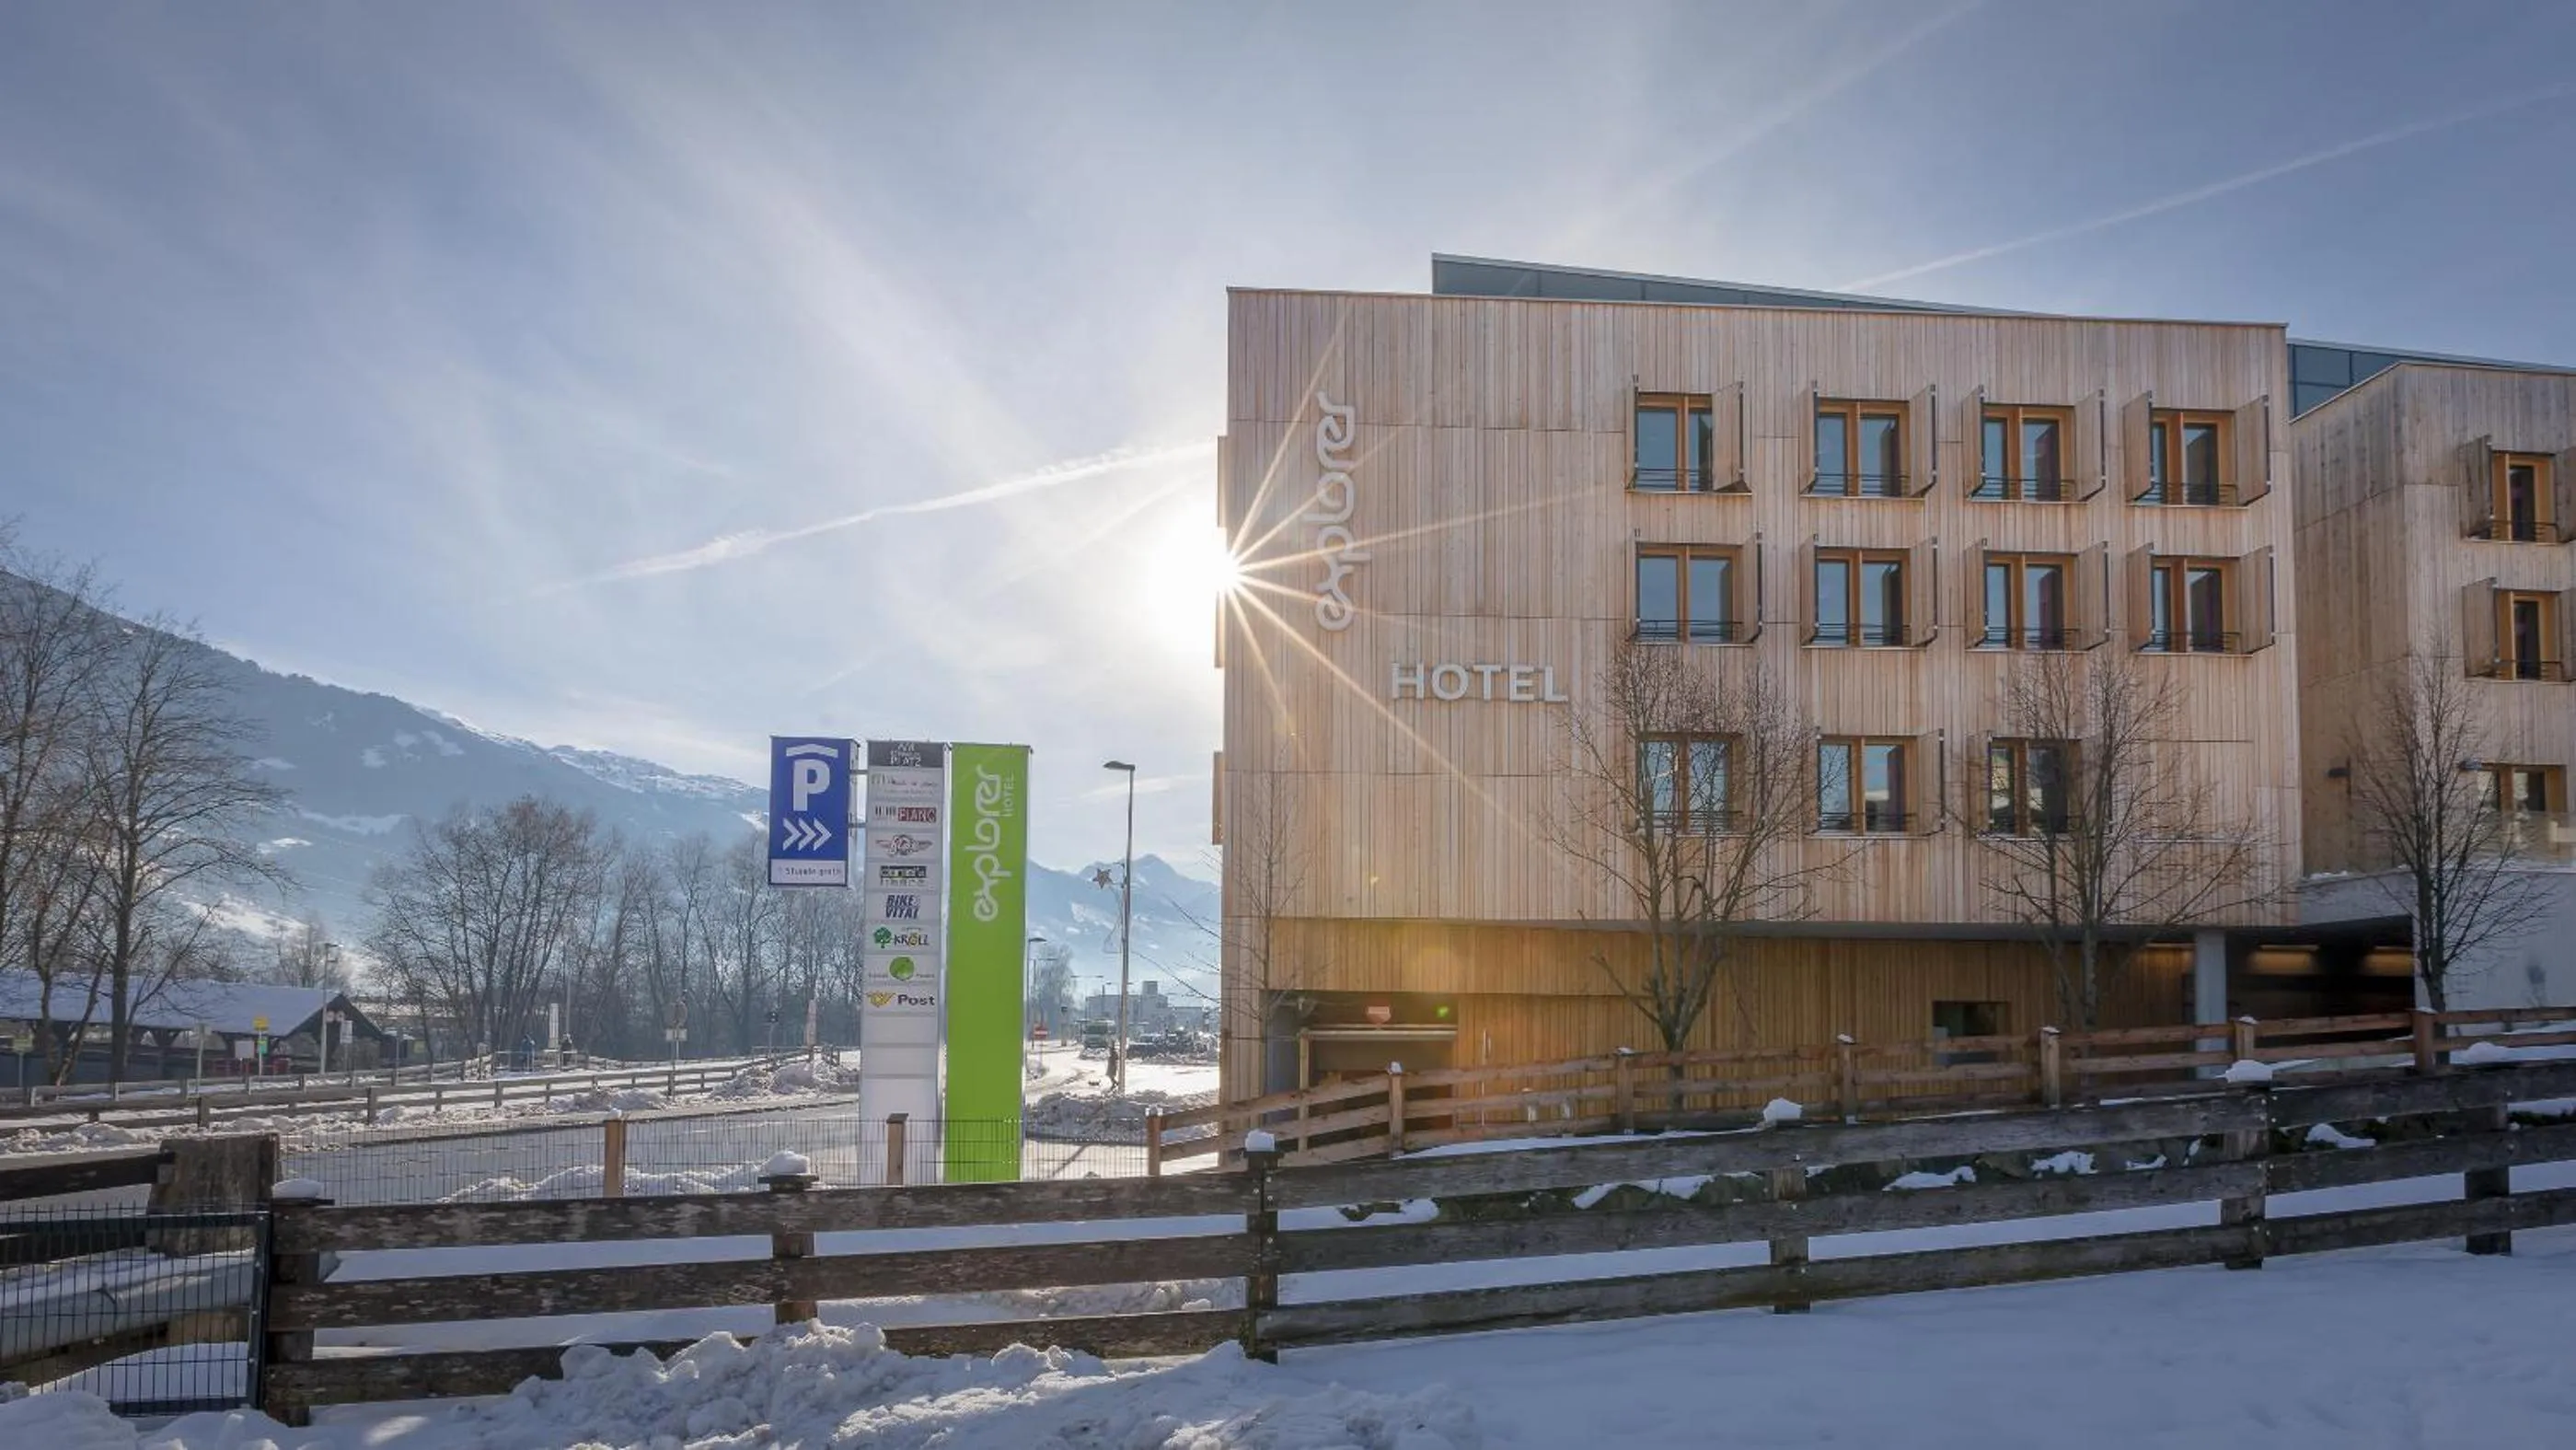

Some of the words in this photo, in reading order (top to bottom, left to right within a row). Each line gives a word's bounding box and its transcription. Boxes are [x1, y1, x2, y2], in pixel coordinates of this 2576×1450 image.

[1301, 389, 1371, 632] explorer
[1391, 662, 1568, 703] HOTEL
[792, 759, 830, 812] P
[1001, 772, 1014, 817] HOTEL
[965, 763, 1011, 922] explorer
[886, 894, 914, 906] BIKE
[897, 994, 935, 1006] Post
